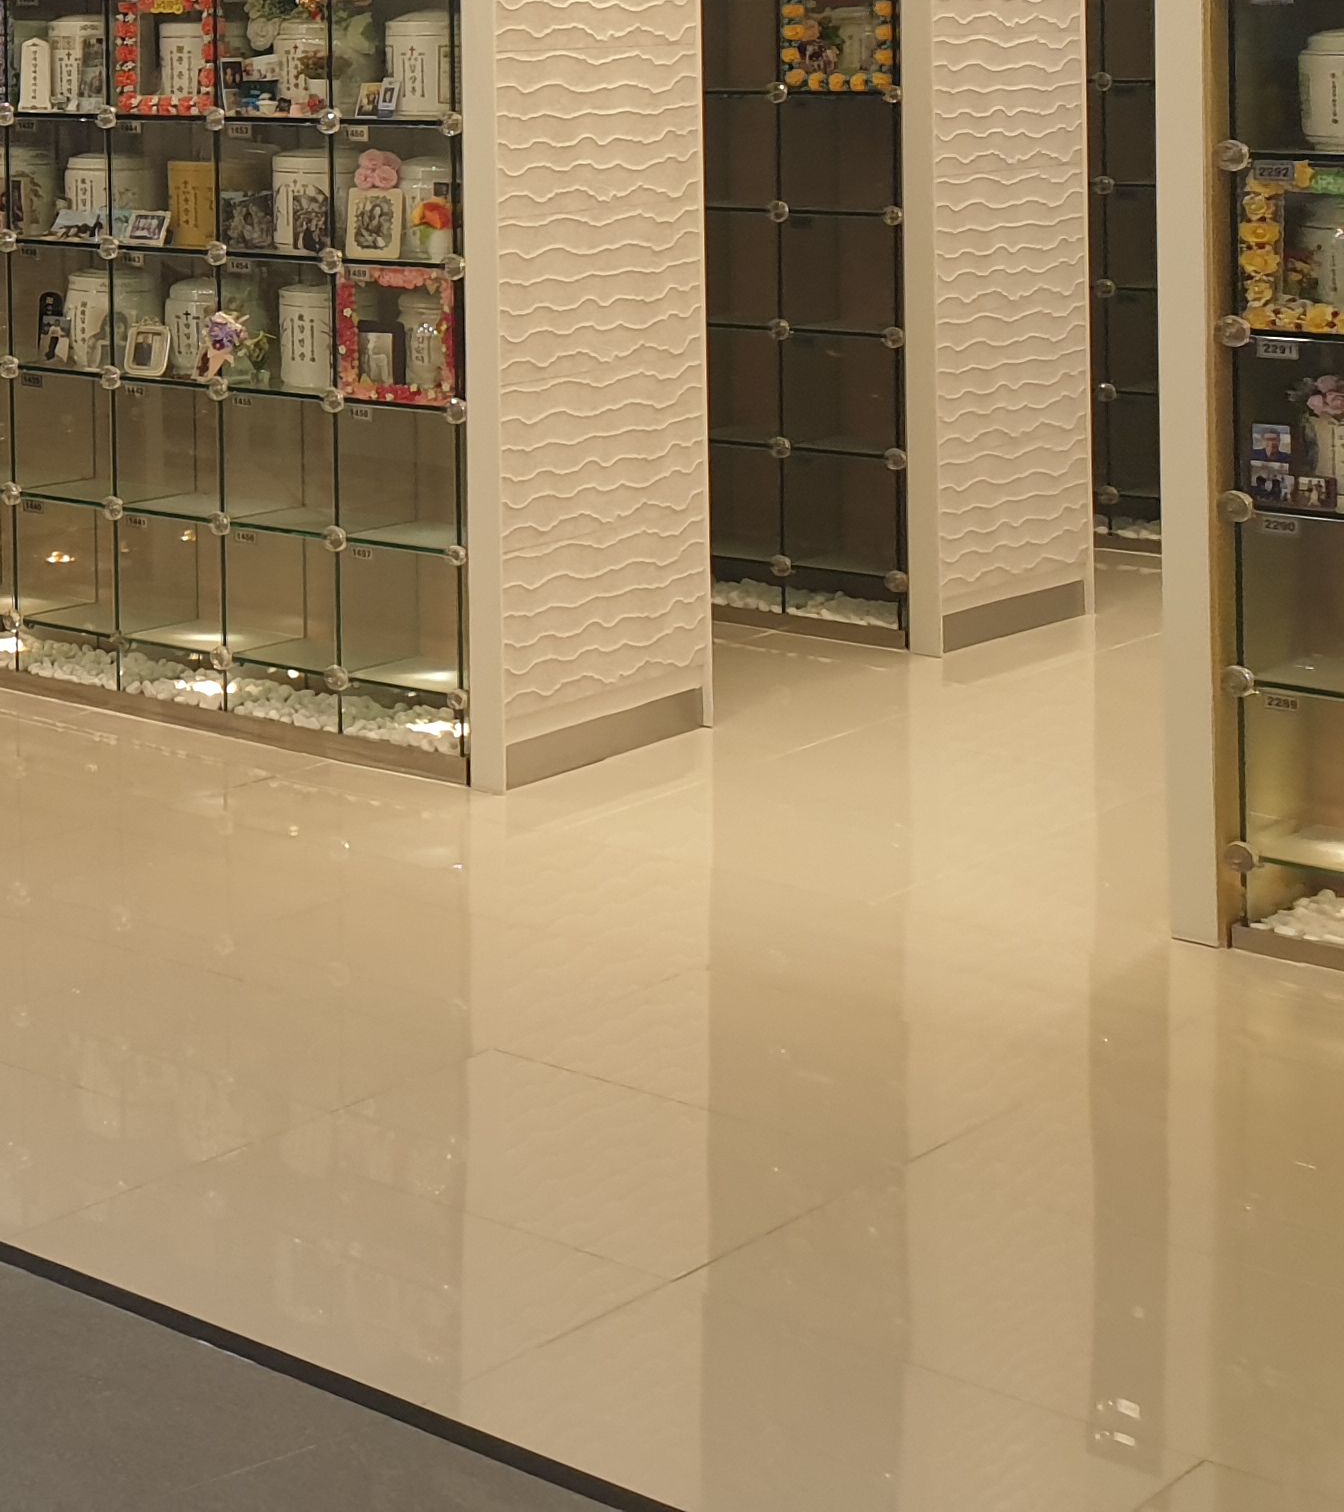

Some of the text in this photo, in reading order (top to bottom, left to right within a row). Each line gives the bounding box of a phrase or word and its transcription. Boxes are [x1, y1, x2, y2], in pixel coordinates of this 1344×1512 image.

[231, 126, 248, 134] 1453
[1259, 167, 1289, 177] 2292
[231, 261, 248, 270] 1454
[1263, 344, 1292, 354] 2291
[126, 386, 143, 394] 1442
